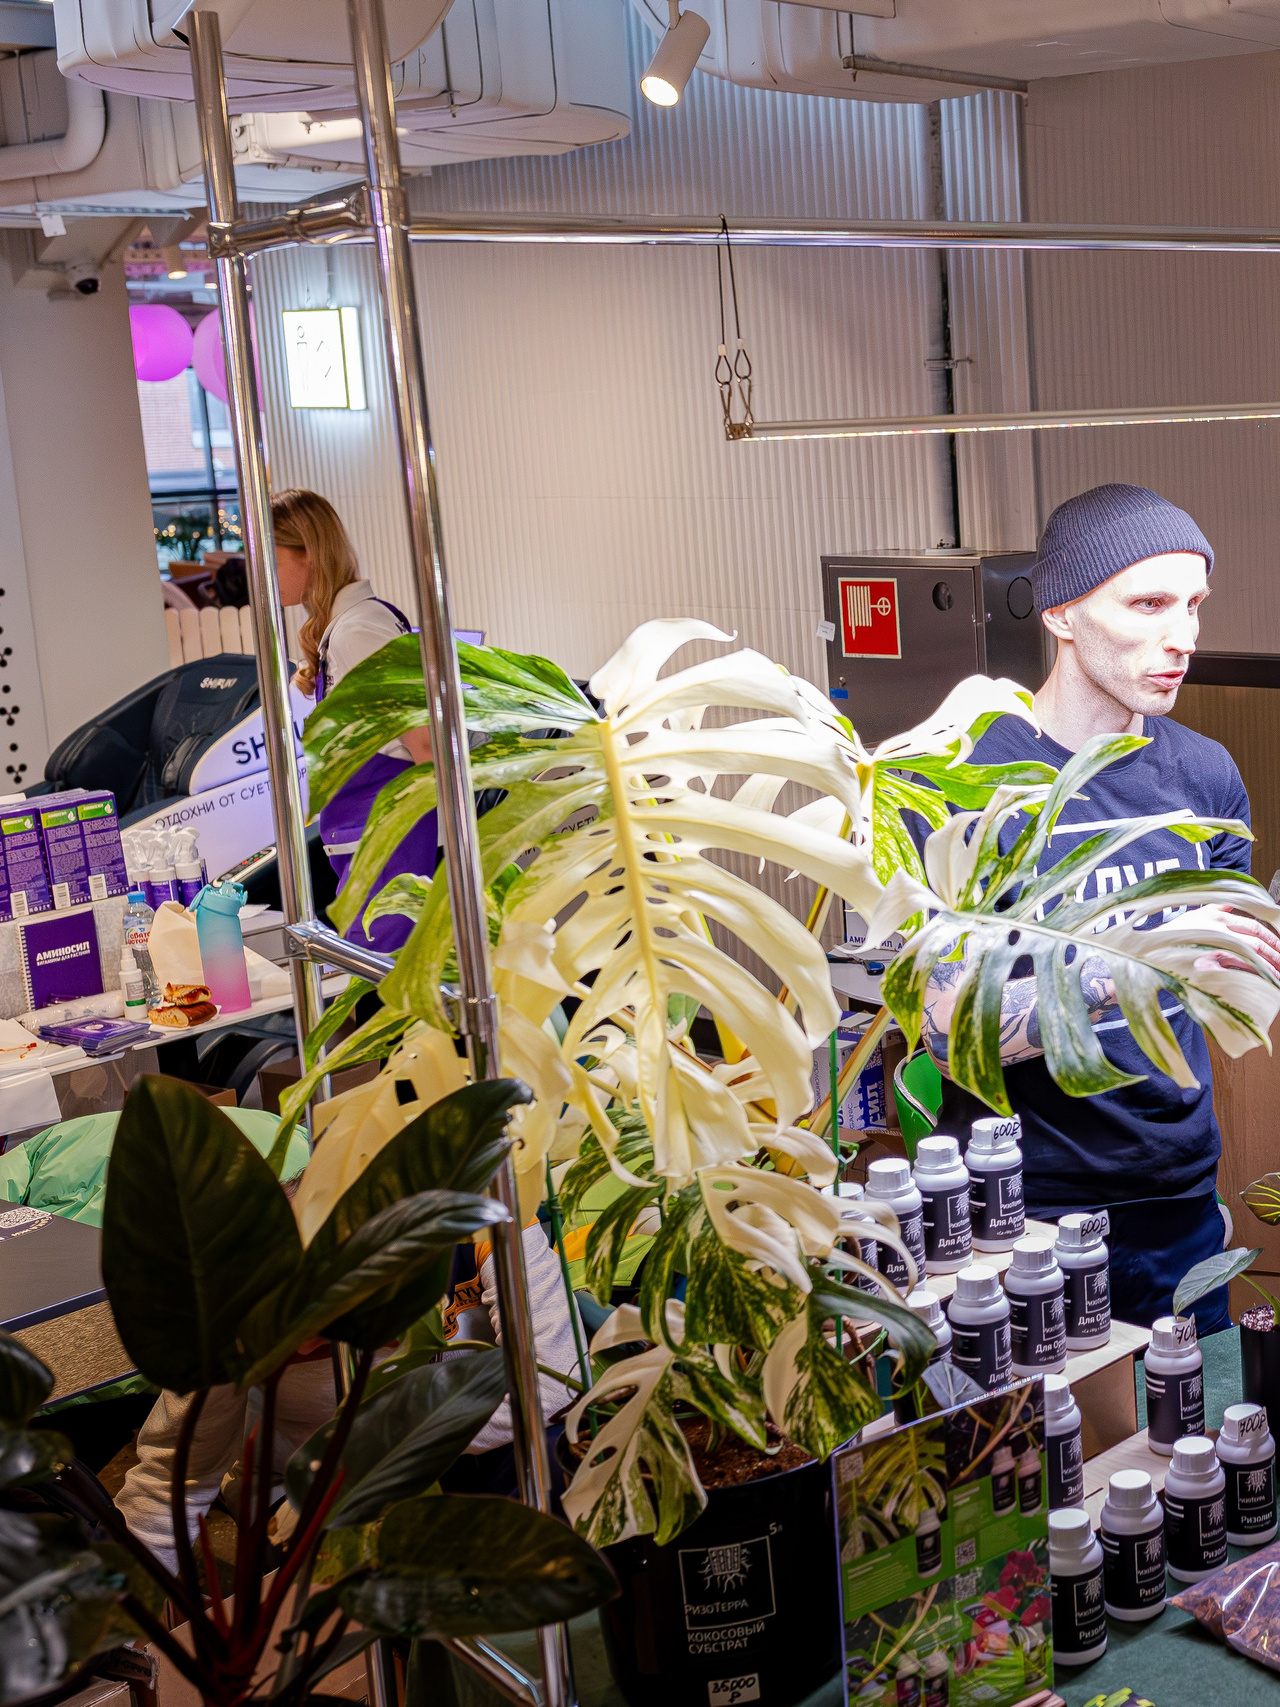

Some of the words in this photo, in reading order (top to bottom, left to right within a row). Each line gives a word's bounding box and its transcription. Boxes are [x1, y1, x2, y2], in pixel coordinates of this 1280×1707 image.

[219, 793, 236, 808] ОТ
[36, 940, 90, 962] АМИНОСИЛ
[989, 1218, 1007, 1228] Для
[938, 1238, 956, 1249] Для
[1078, 1316, 1095, 1326] Для
[1035, 1343, 1053, 1355] Для
[687, 1620, 766, 1643] КОКОСОВЫЙ
[688, 1637, 749, 1655] СУБСТРАТ
